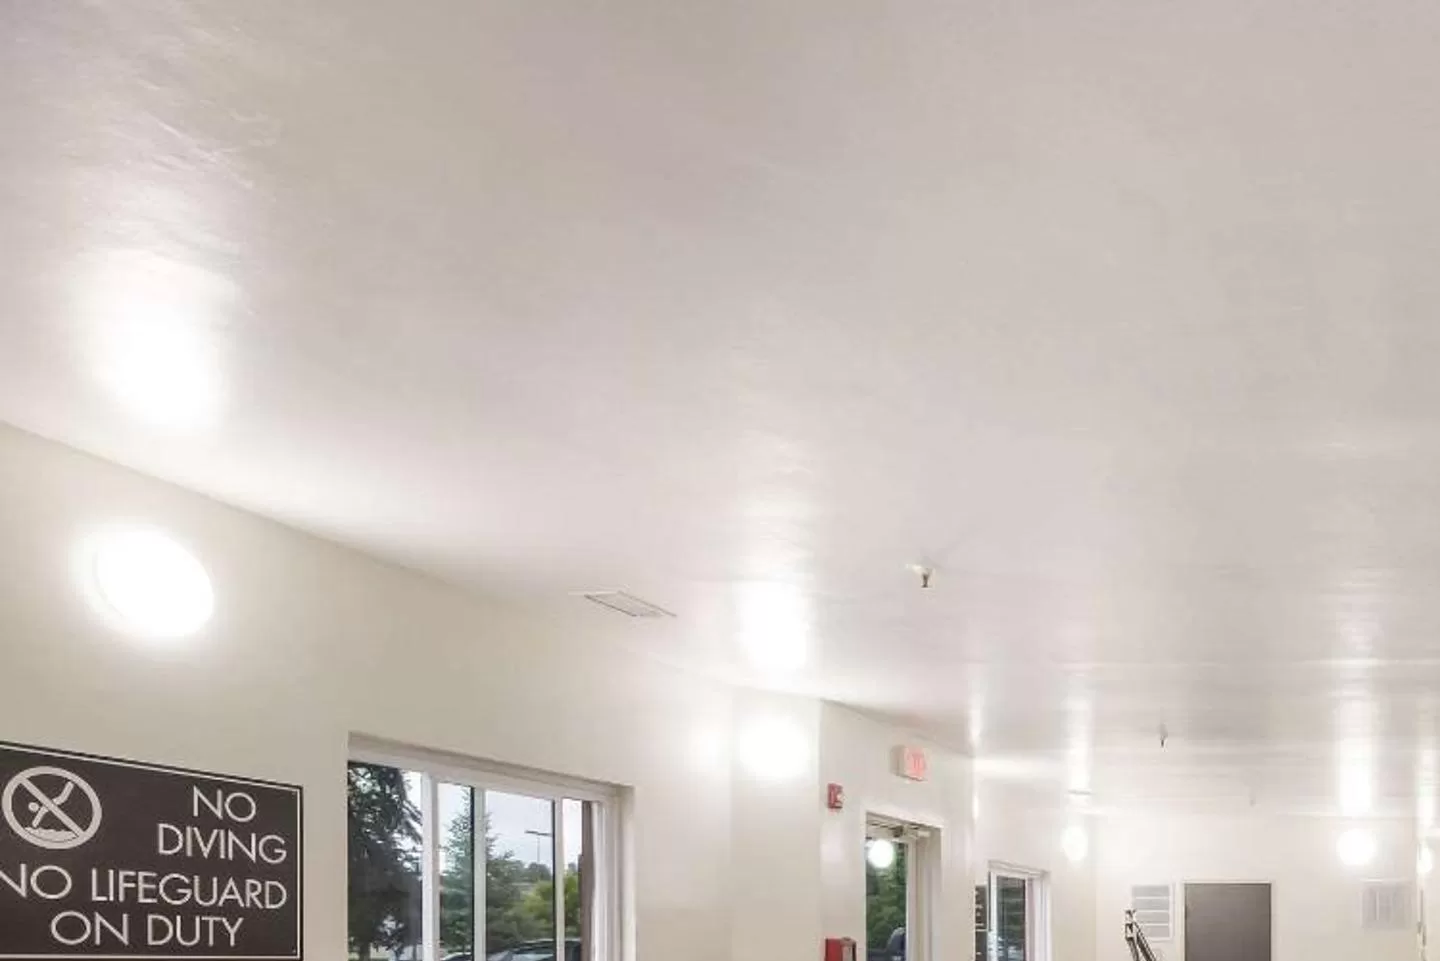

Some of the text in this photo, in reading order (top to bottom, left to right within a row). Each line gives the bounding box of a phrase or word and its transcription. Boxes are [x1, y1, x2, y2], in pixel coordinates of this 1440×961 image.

[192, 784, 257, 823] NO
[157, 822, 288, 865] DIVING
[91, 866, 288, 910] LIFEGUARD
[50, 909, 244, 947] ON DUTY
